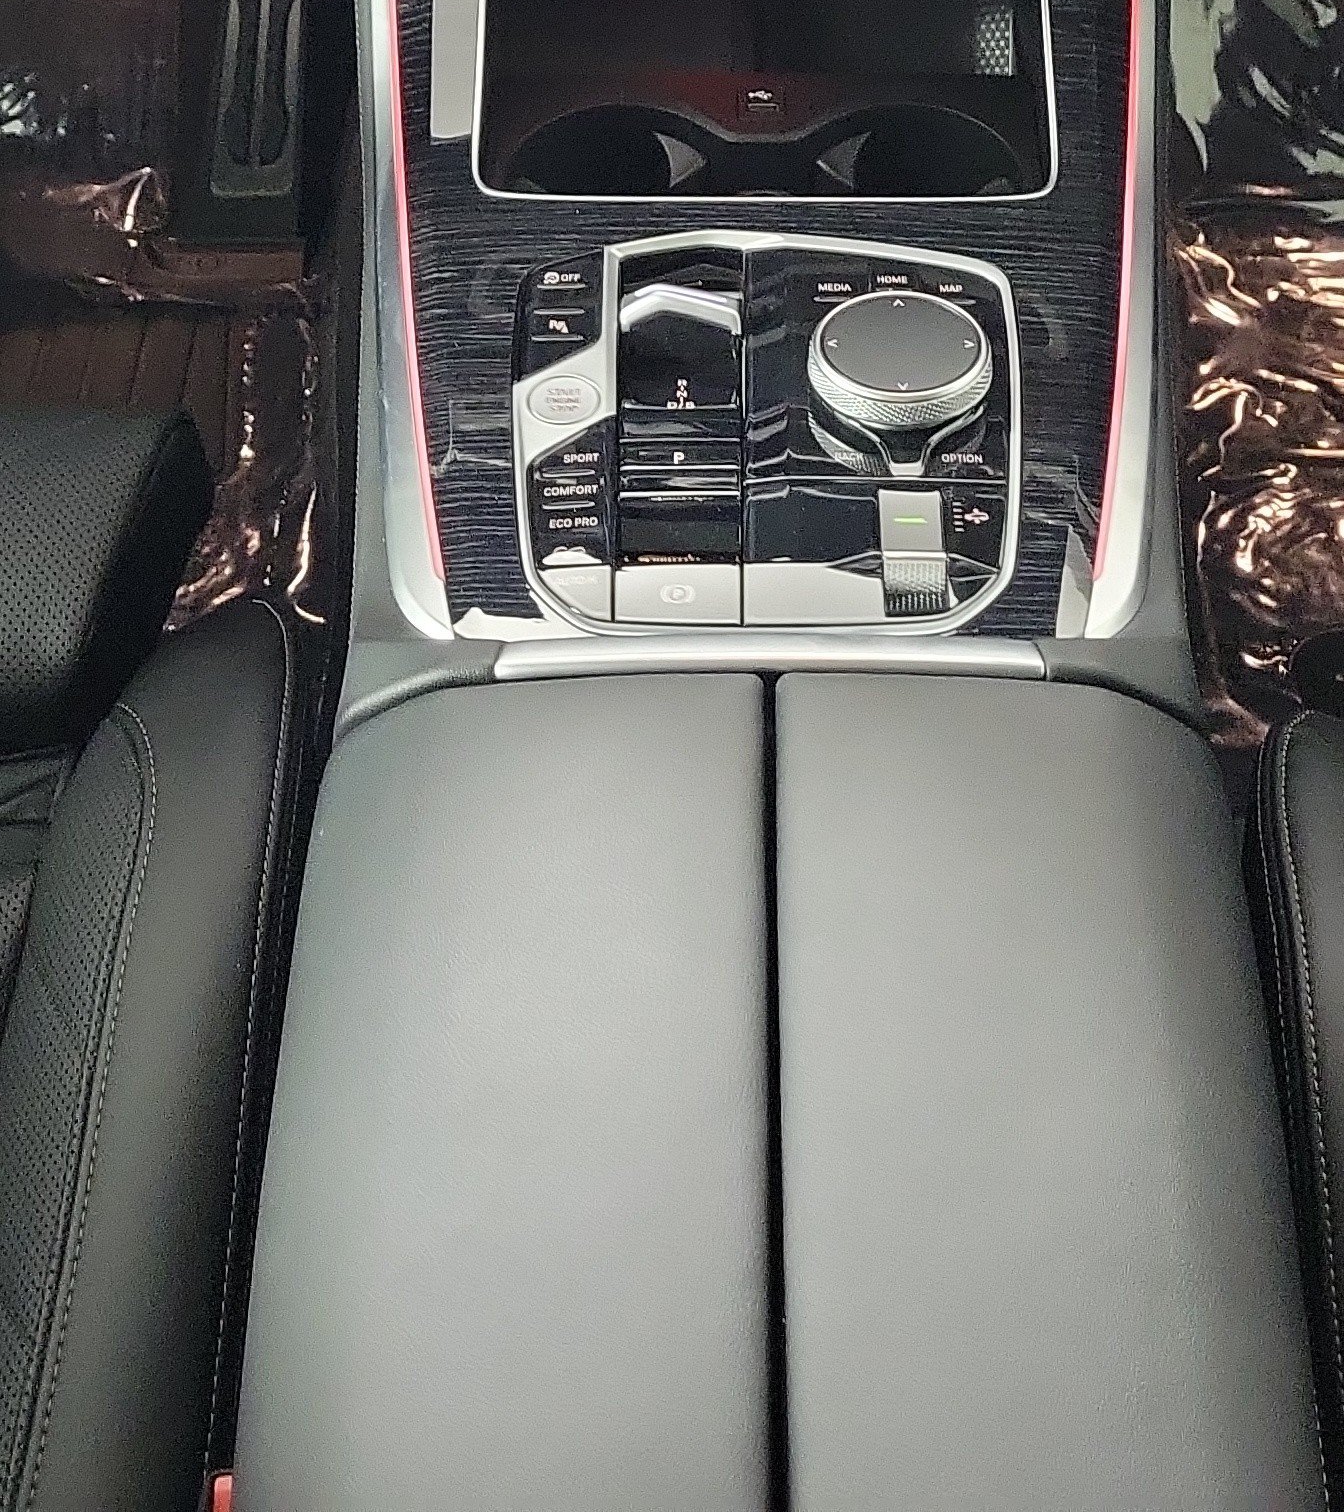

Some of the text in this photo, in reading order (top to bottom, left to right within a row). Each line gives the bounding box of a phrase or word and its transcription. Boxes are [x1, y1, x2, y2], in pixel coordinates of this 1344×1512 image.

[560, 273, 581, 282] OFF
[876, 275, 908, 285] HOME
[817, 282, 852, 293] MEDIA
[939, 284, 963, 293] MAP
[563, 452, 599, 464] SPORT
[673, 451, 685, 465] P
[941, 453, 983, 464] OPTION
[543, 484, 599, 497] COMFORT
[549, 516, 599, 529] ECO PRO
